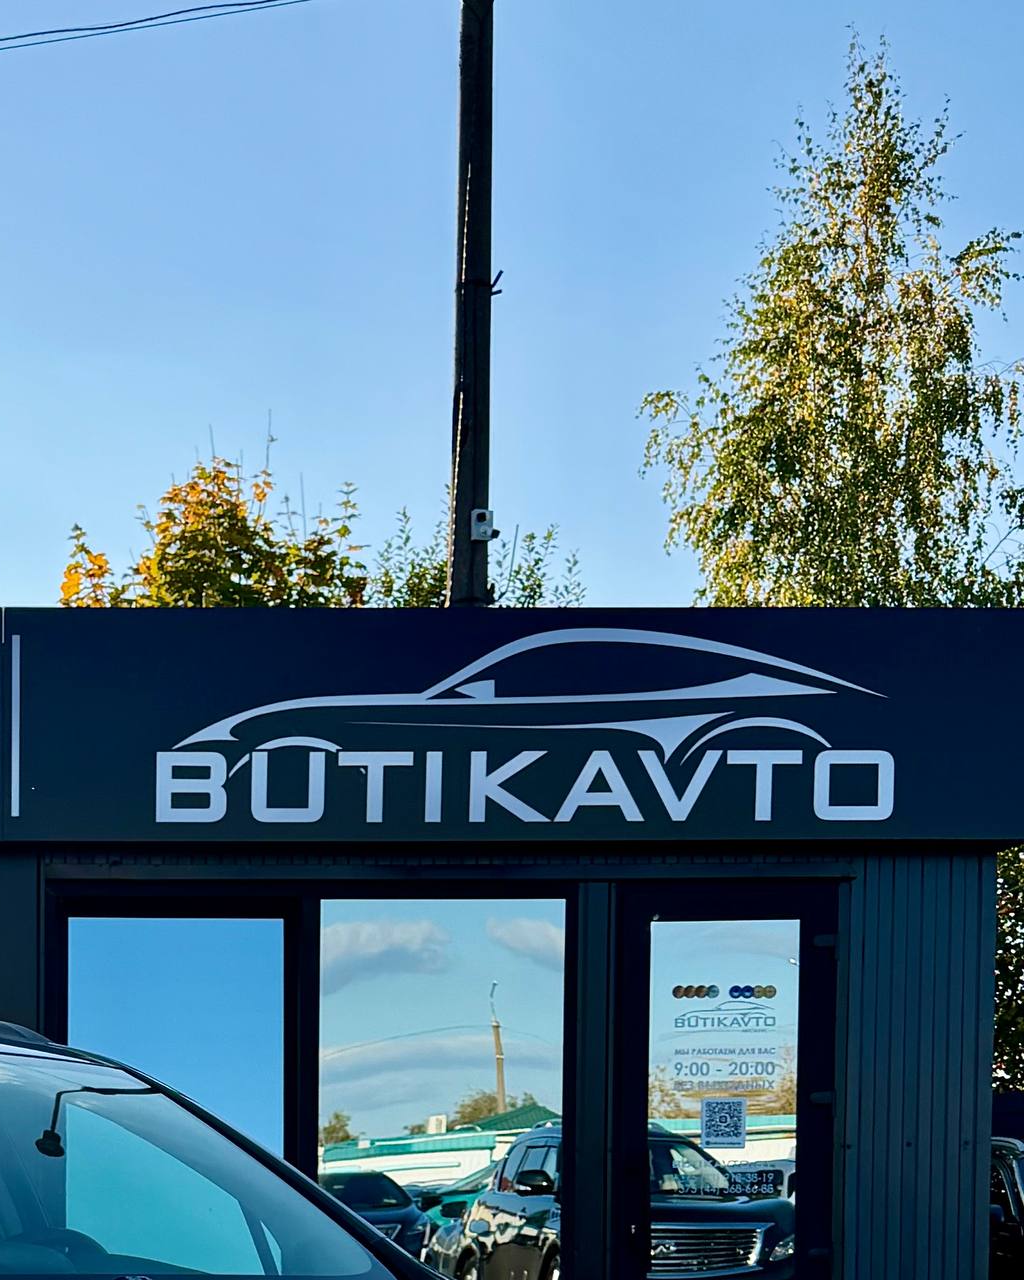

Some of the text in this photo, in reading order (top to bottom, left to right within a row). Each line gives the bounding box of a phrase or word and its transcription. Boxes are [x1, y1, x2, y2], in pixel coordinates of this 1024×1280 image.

[155, 749, 895, 823] BUTIKAVTO
[674, 1016, 776, 1028] BUTIKAVTO
[674, 1062, 711, 1076] 9:00
[728, 1061, 776, 1076] 20:00
